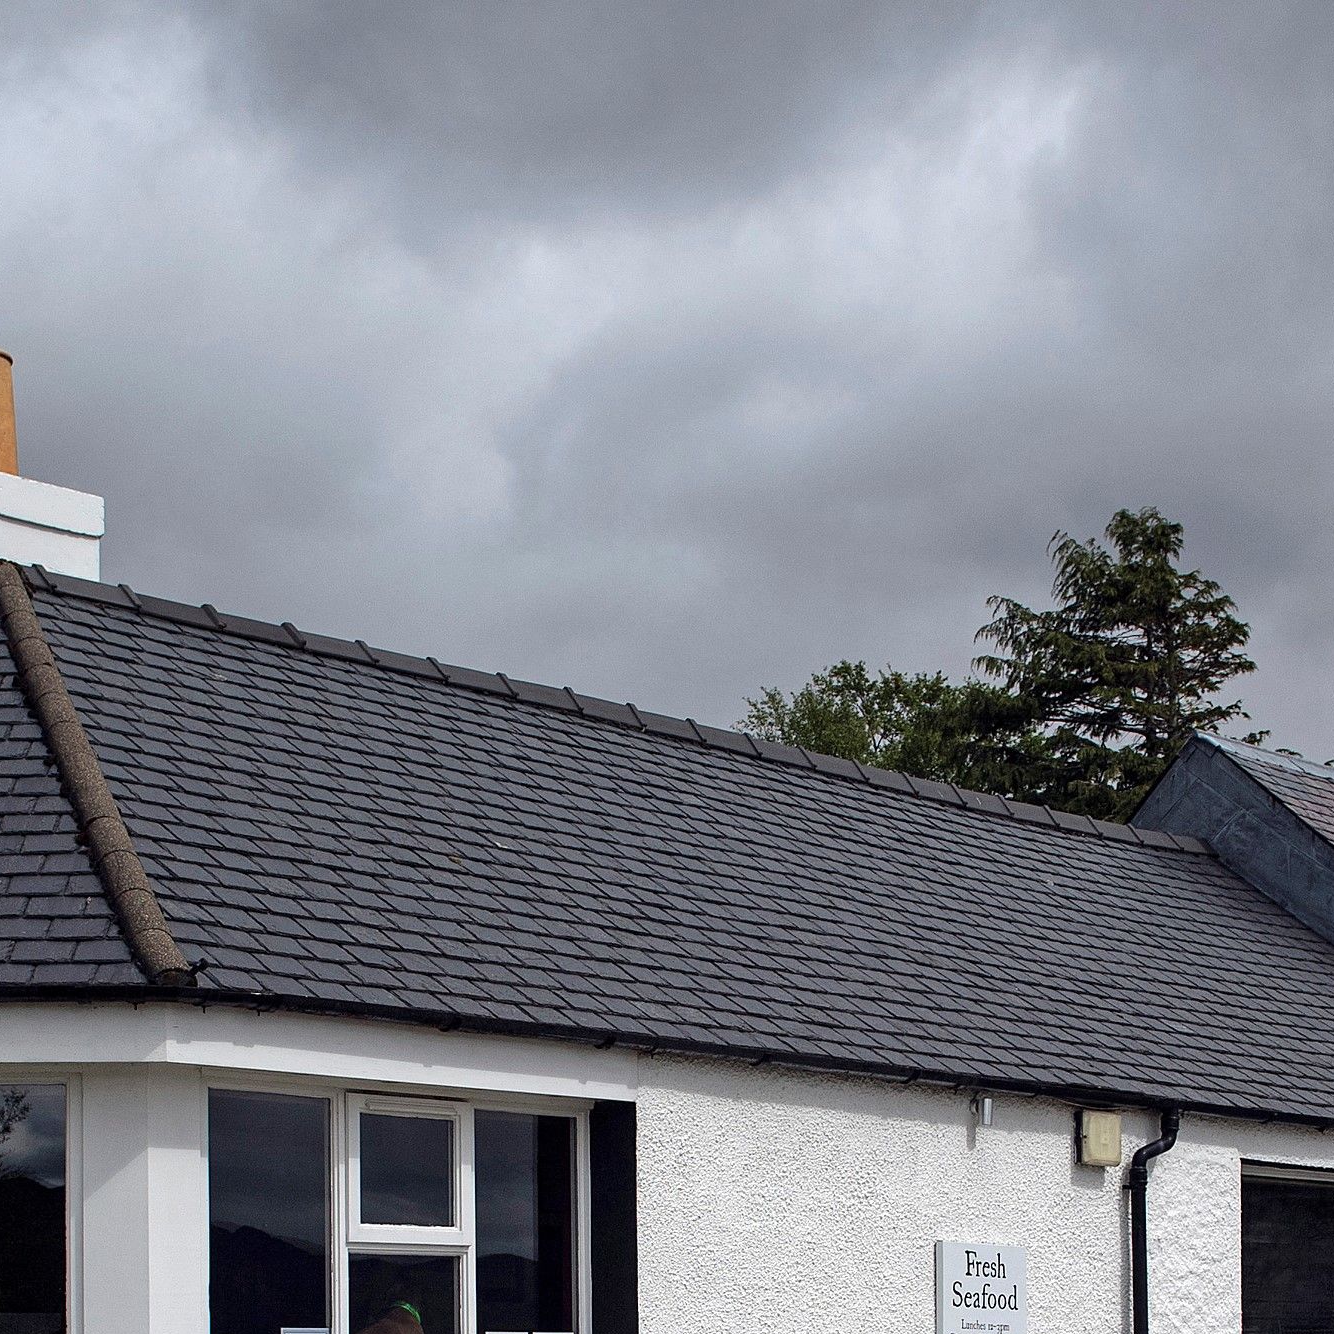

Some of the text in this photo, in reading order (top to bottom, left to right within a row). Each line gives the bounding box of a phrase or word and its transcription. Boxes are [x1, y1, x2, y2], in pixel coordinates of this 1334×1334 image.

[965, 1250, 1006, 1278] Fresh
[952, 1281, 1018, 1310] Seafood
[961, 1319, 986, 1330] Lunches
